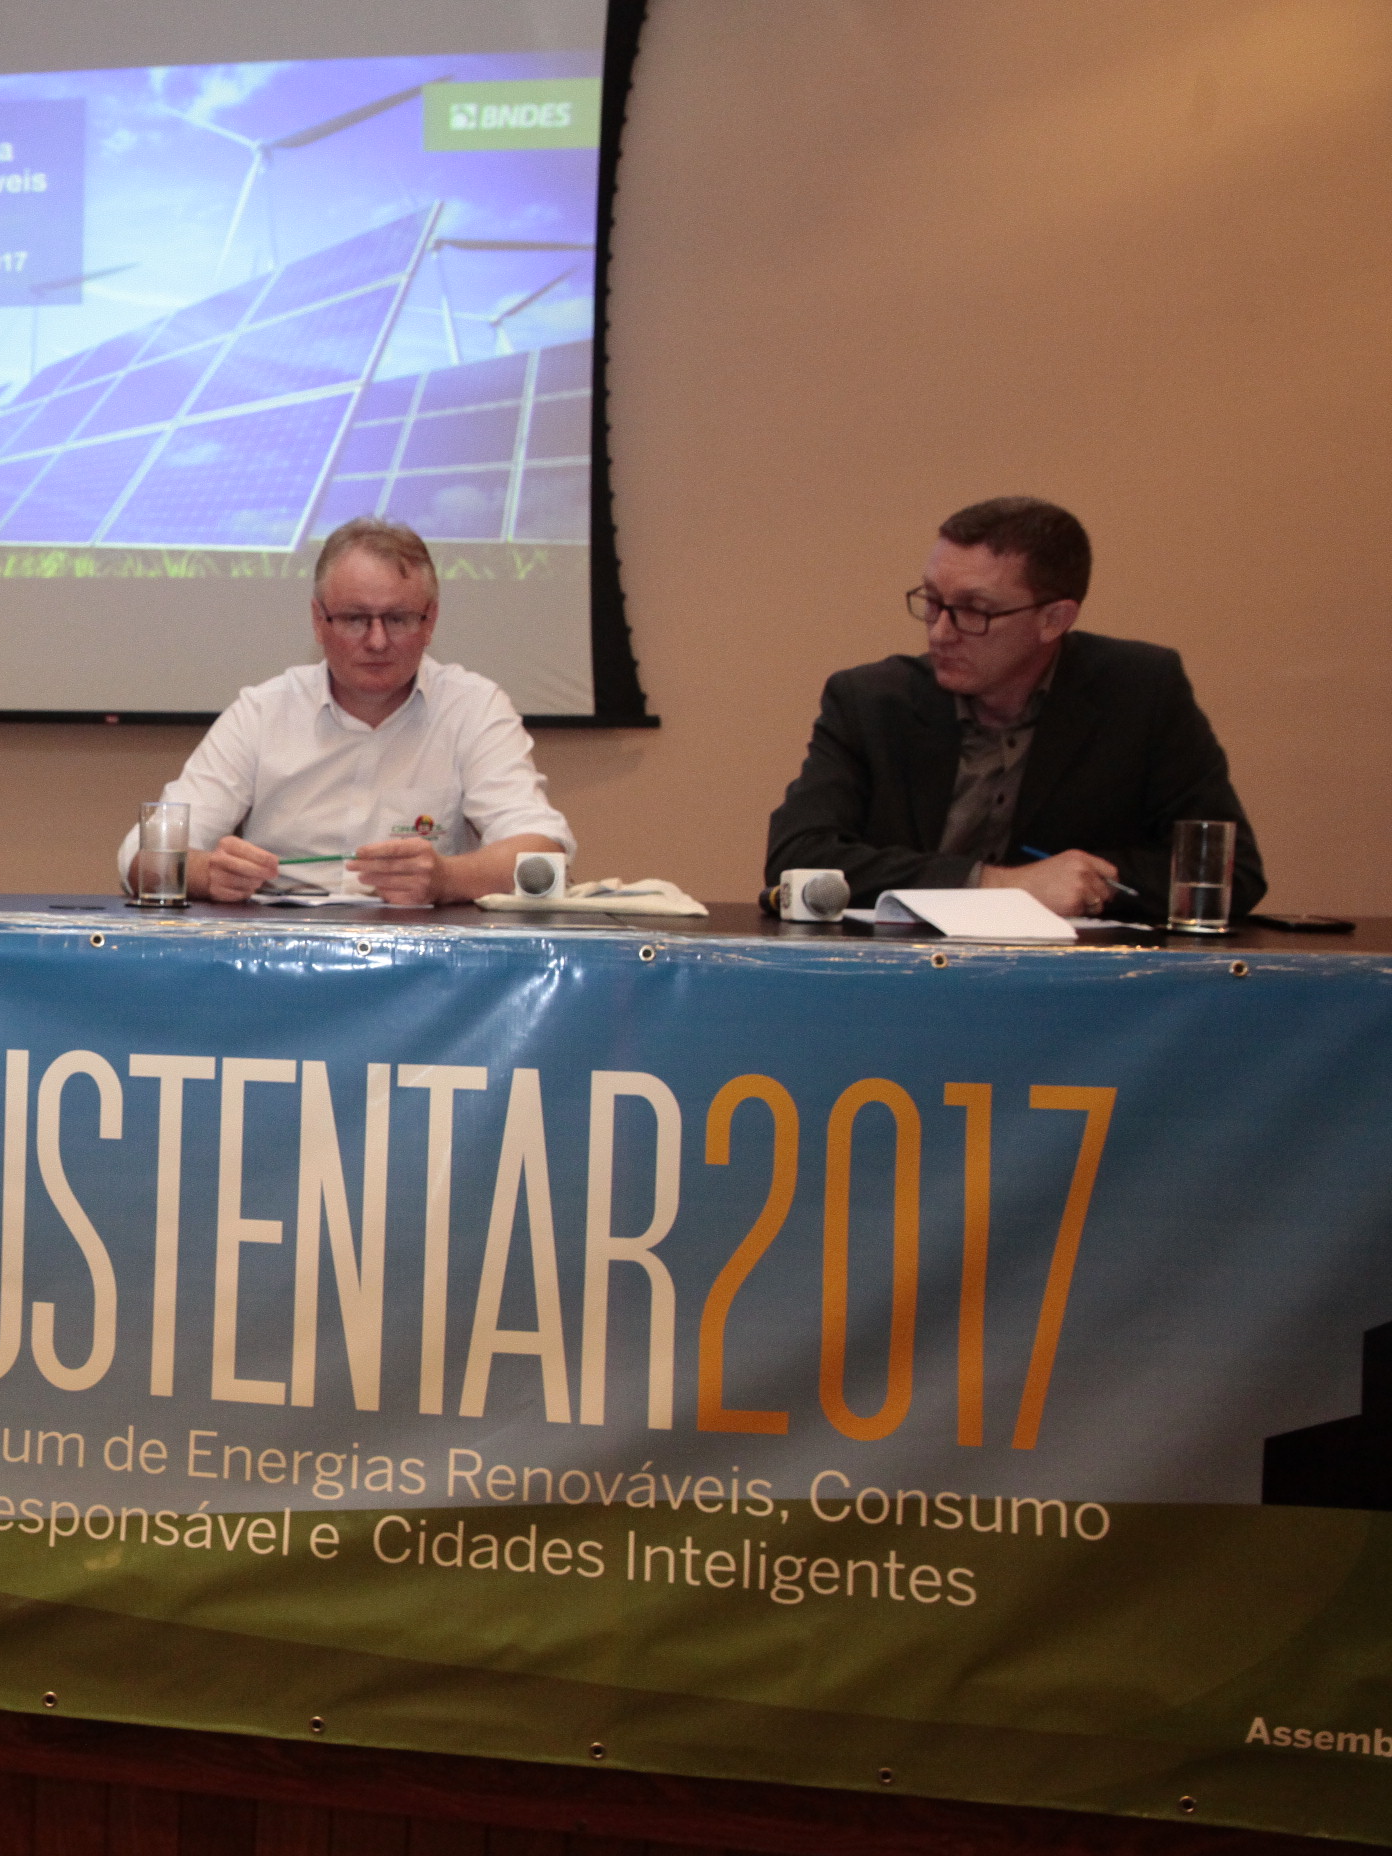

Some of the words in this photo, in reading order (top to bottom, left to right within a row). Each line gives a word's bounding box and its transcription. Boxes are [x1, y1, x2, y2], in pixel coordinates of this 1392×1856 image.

[481, 102, 573, 130] BNDES
[103, 1425, 169, 1475] de
[187, 1429, 427, 1501] Energias
[446, 1447, 791, 1524] Renováveis,
[809, 1469, 1112, 1542] Consumo
[308, 1522, 341, 1560] e
[372, 1514, 607, 1578] Cidades
[626, 1529, 979, 1608] Inteligentes
[1244, 1716, 1392, 1758] Assemb
